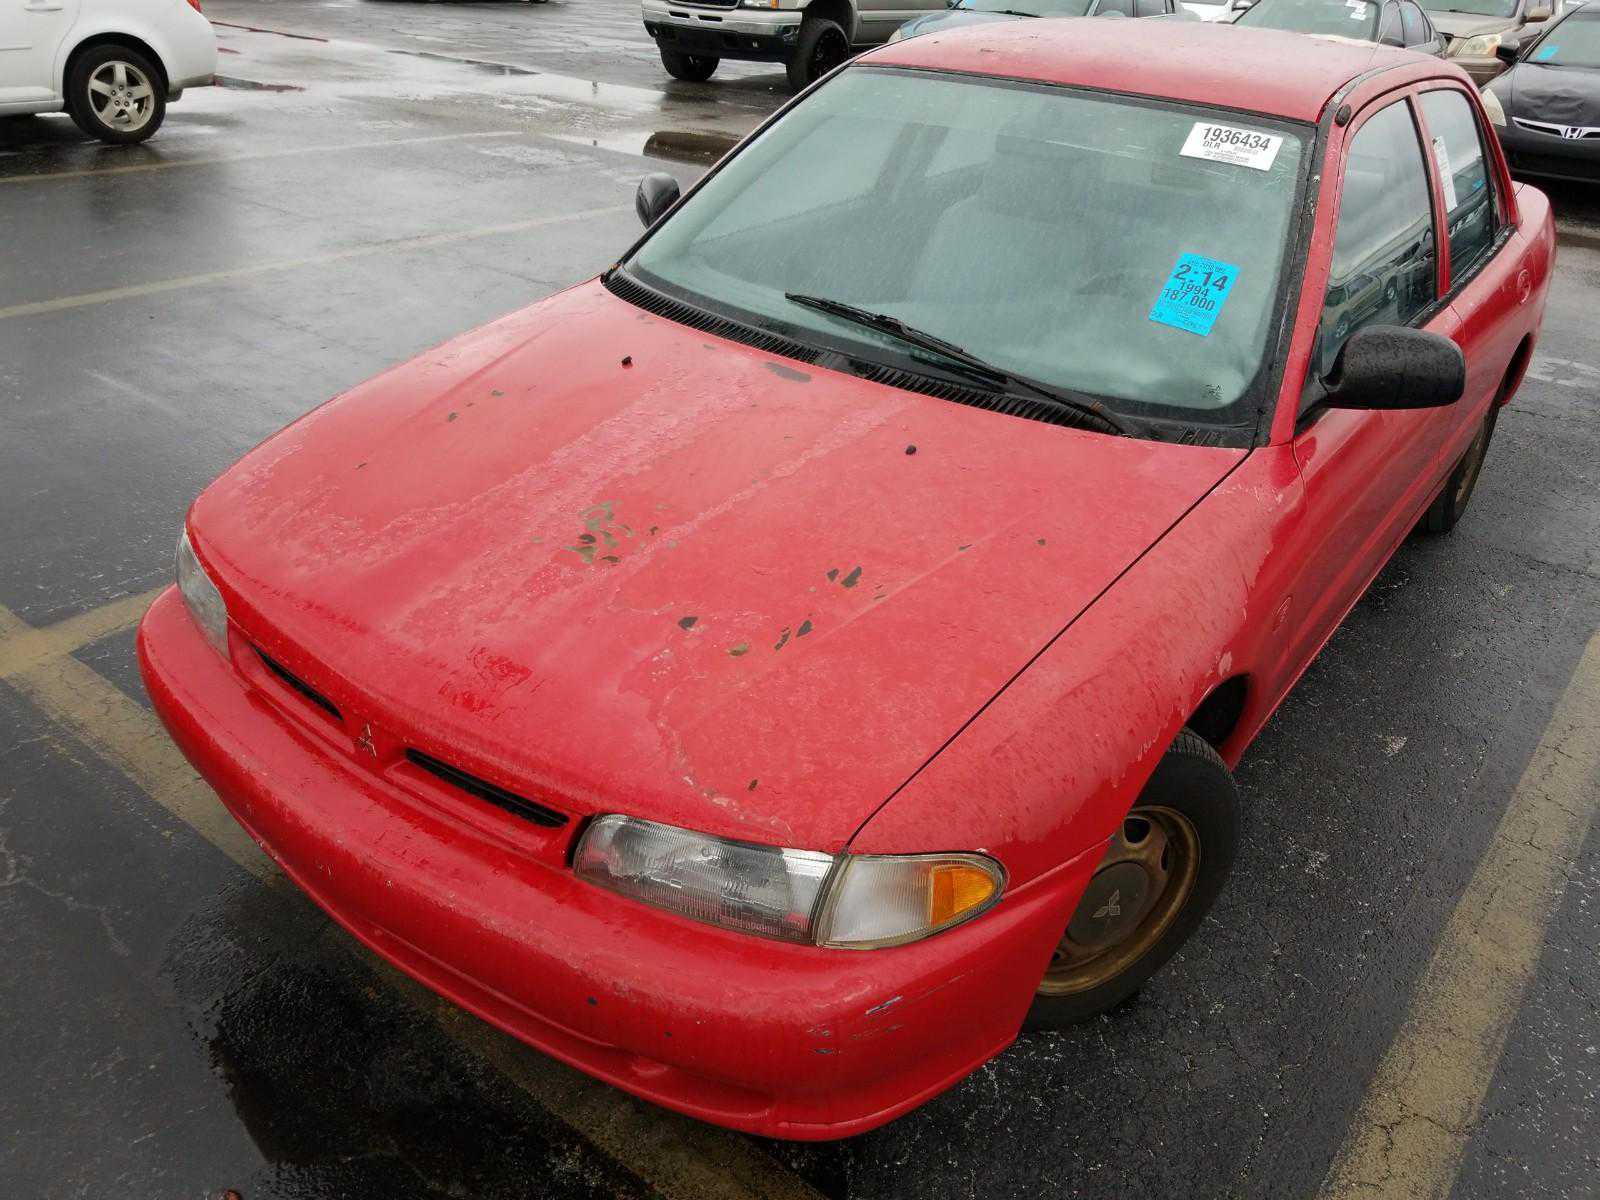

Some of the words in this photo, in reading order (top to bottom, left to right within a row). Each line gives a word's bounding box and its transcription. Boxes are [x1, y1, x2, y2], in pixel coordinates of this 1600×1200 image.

[1203, 127, 1271, 151] 1936434
[1203, 141, 1221, 150] DLR
[1180, 282, 1210, 297] 1994
